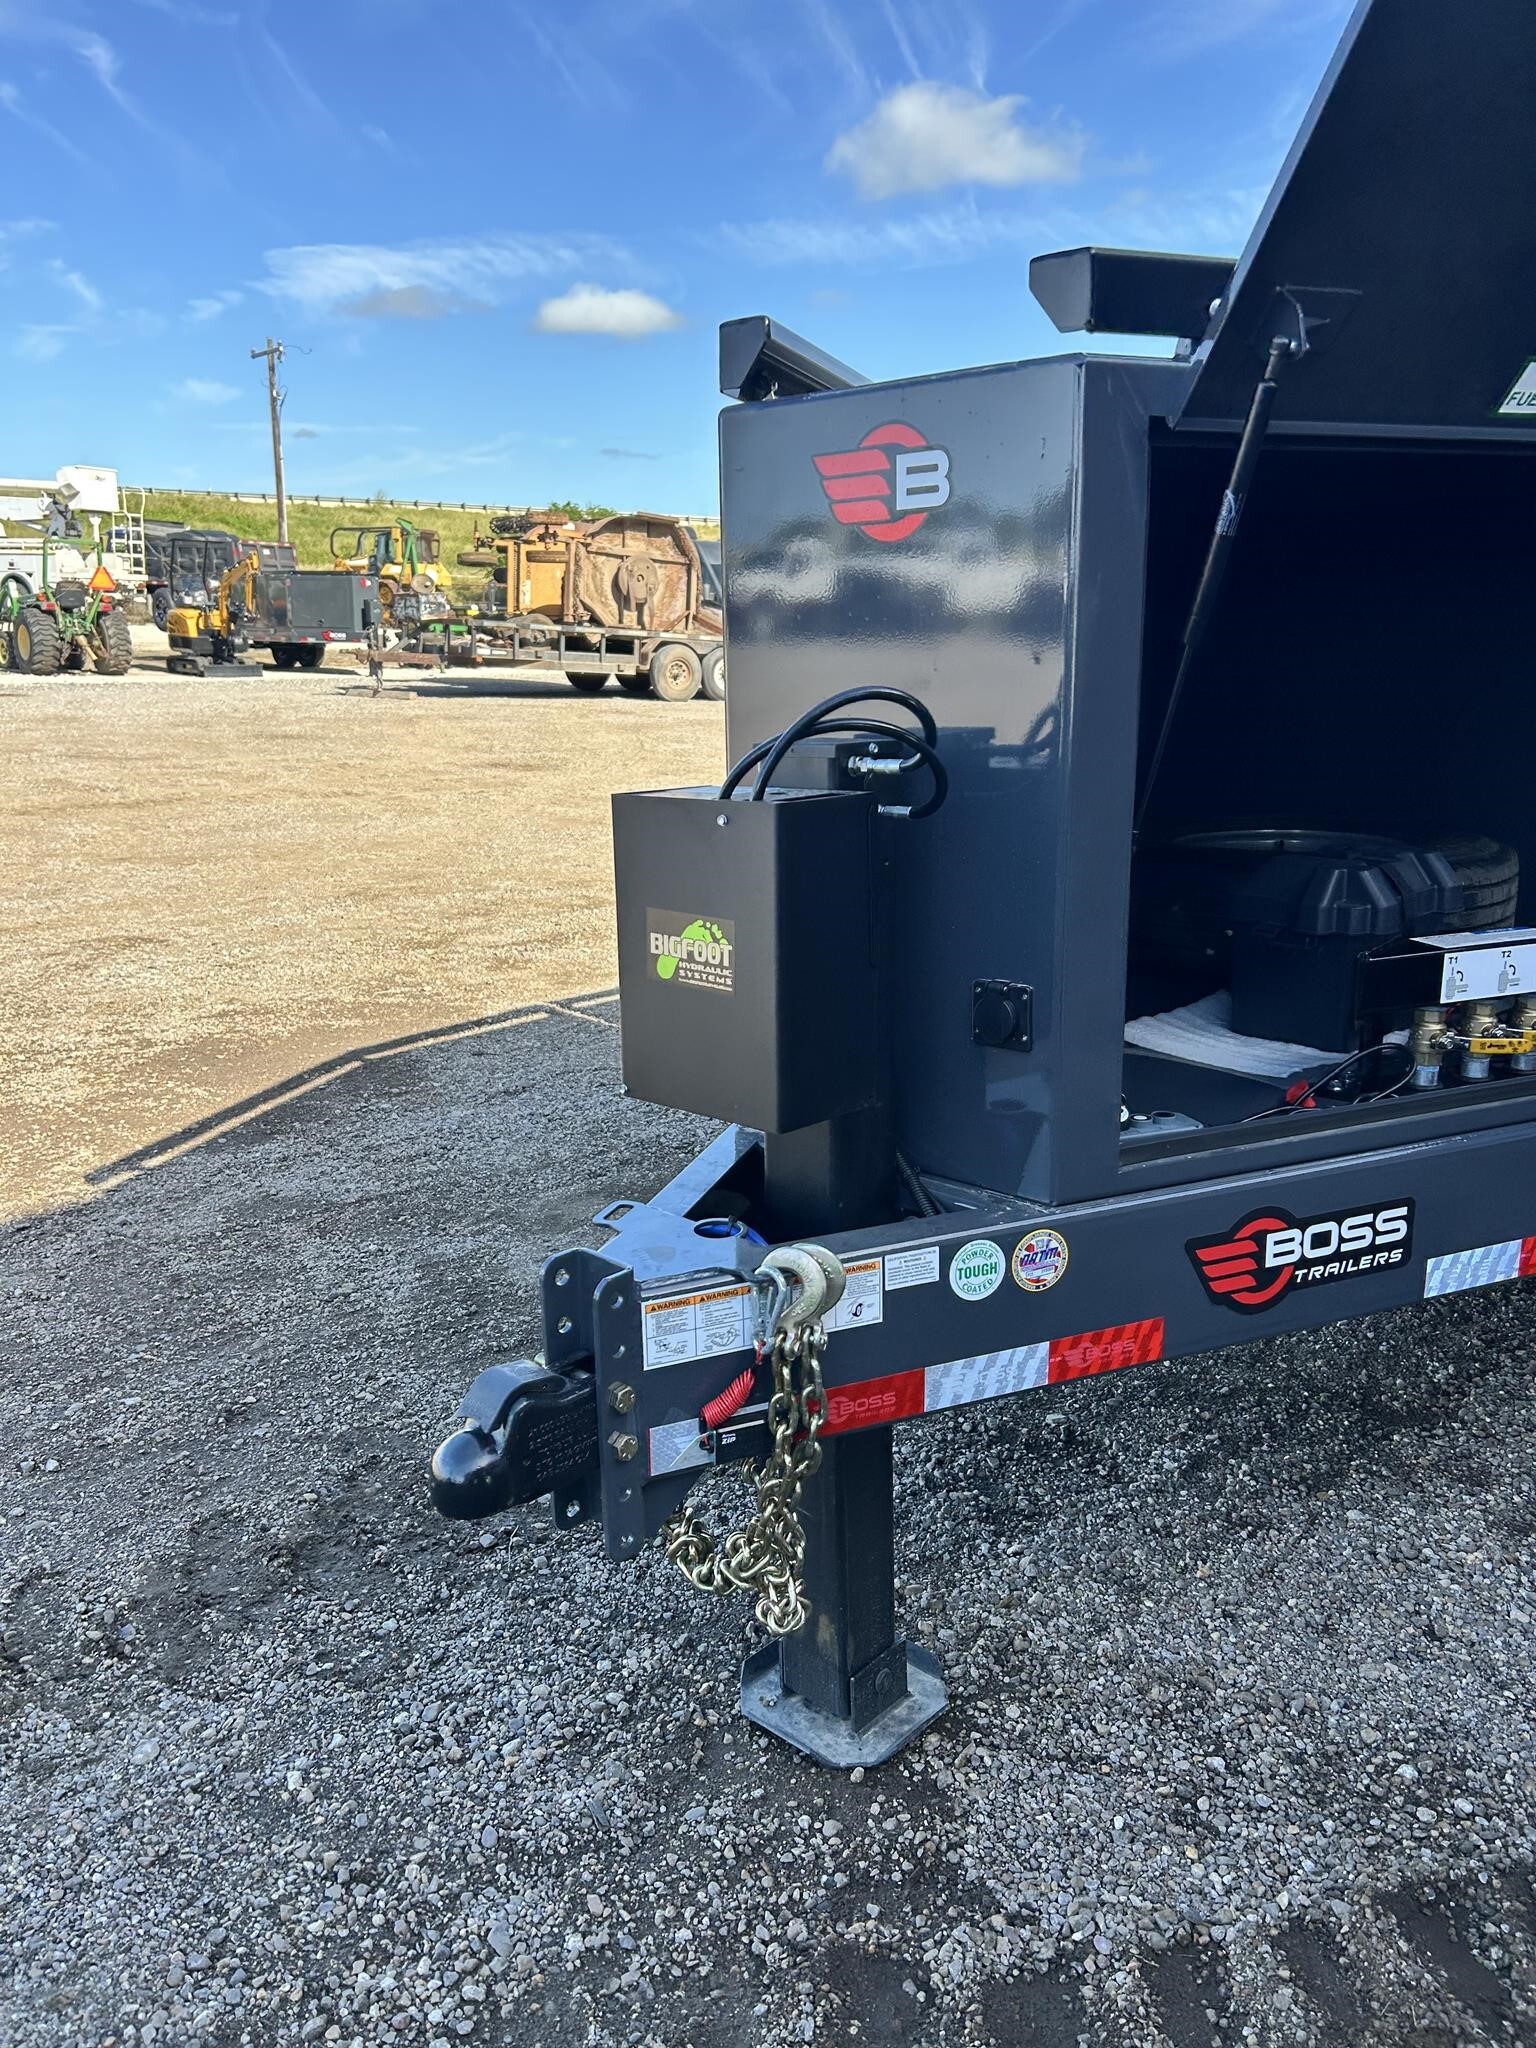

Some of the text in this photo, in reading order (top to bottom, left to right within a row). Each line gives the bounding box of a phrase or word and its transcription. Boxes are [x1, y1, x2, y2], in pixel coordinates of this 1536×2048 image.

[650, 932, 733, 967] BIGFOOT
[1501, 950, 1512, 958] T2
[1448, 956, 1459, 965] T1
[678, 961, 733, 977] HYDRAULIC
[678, 969, 733, 985] SYSTEMS
[1265, 1206, 1408, 1268] BOSS
[961, 1249, 994, 1265] POWDER
[845, 1263, 877, 1274] WARNING
[957, 1261, 998, 1281] TOUGH
[1294, 1248, 1404, 1283] TRAILERS
[962, 1278, 994, 1293] COATED
[705, 1289, 739, 1302] WARNING
[657, 1298, 691, 1311] WARNING
[1085, 1338, 1136, 1360] BOSS
[839, 1391, 897, 1416] BOSS
